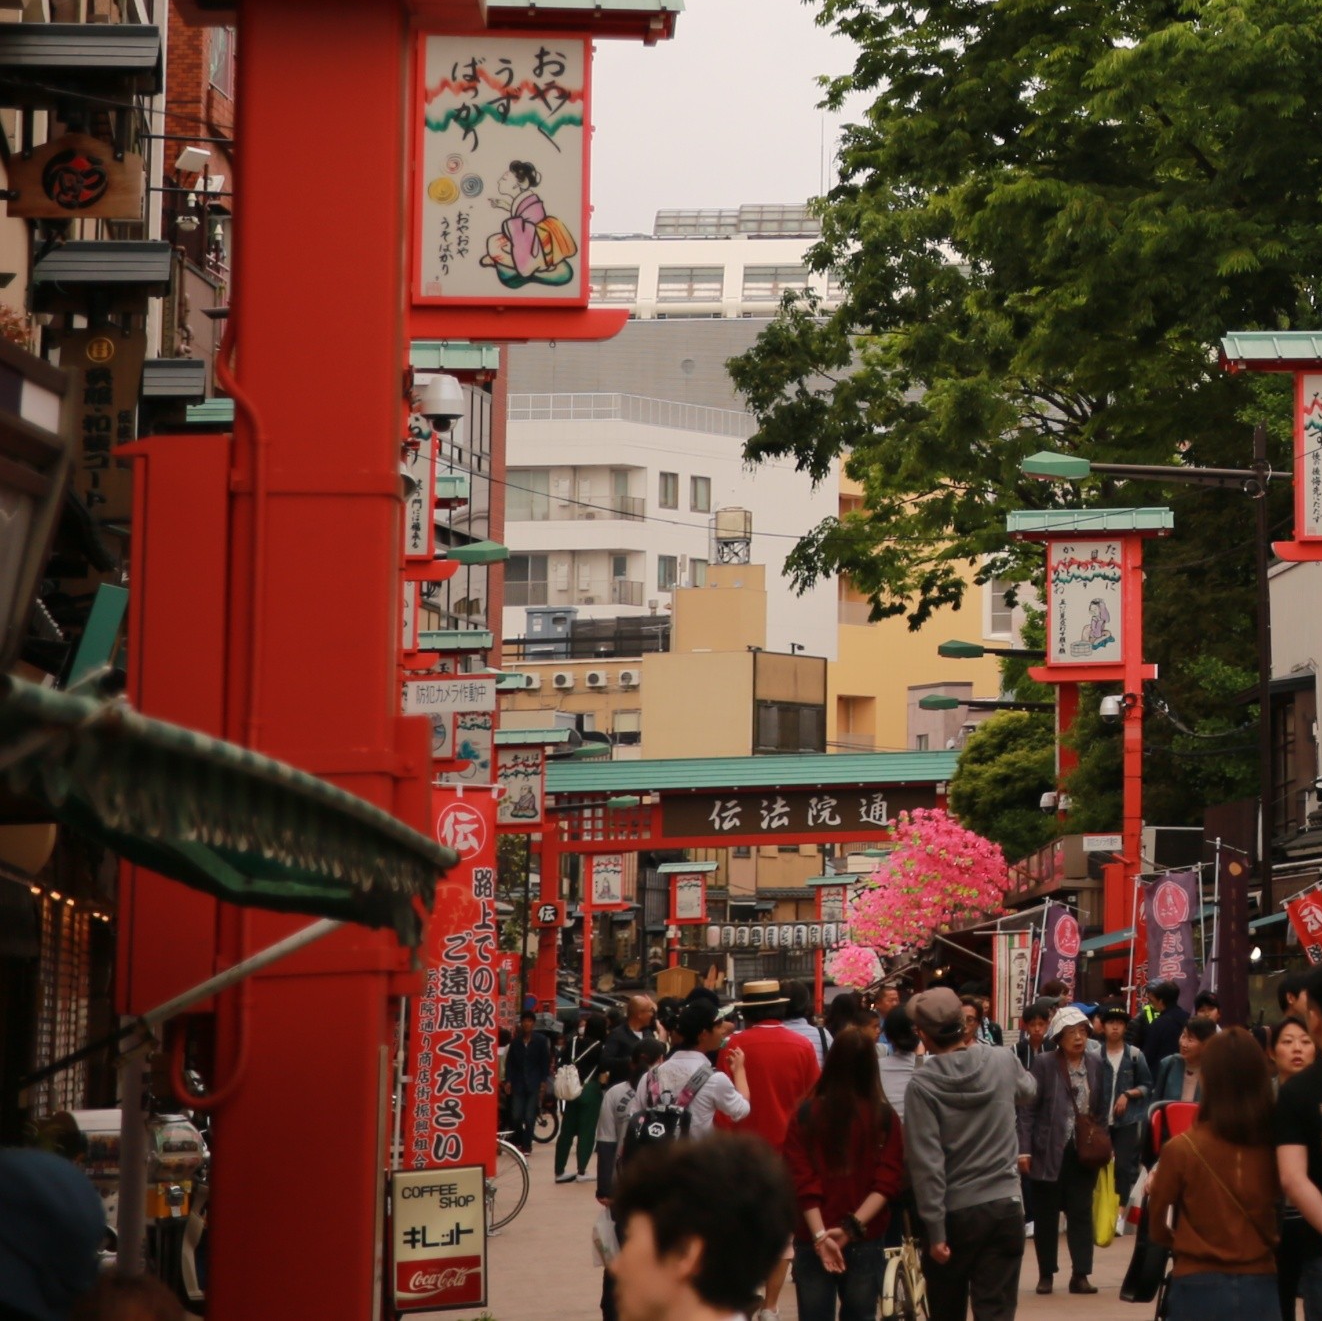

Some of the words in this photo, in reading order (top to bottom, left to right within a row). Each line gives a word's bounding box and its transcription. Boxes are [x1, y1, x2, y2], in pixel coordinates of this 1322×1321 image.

[415, 682, 487, 705] 防犯カメラ作動中
[707, 792, 891, 831] 伝法院通
[468, 868, 496, 1096] 路上での飲食は
[432, 930, 476, 1162] ご遠慮ください
[401, 1183, 458, 1200] COFFEE
[439, 1194, 476, 1210] SHOP
